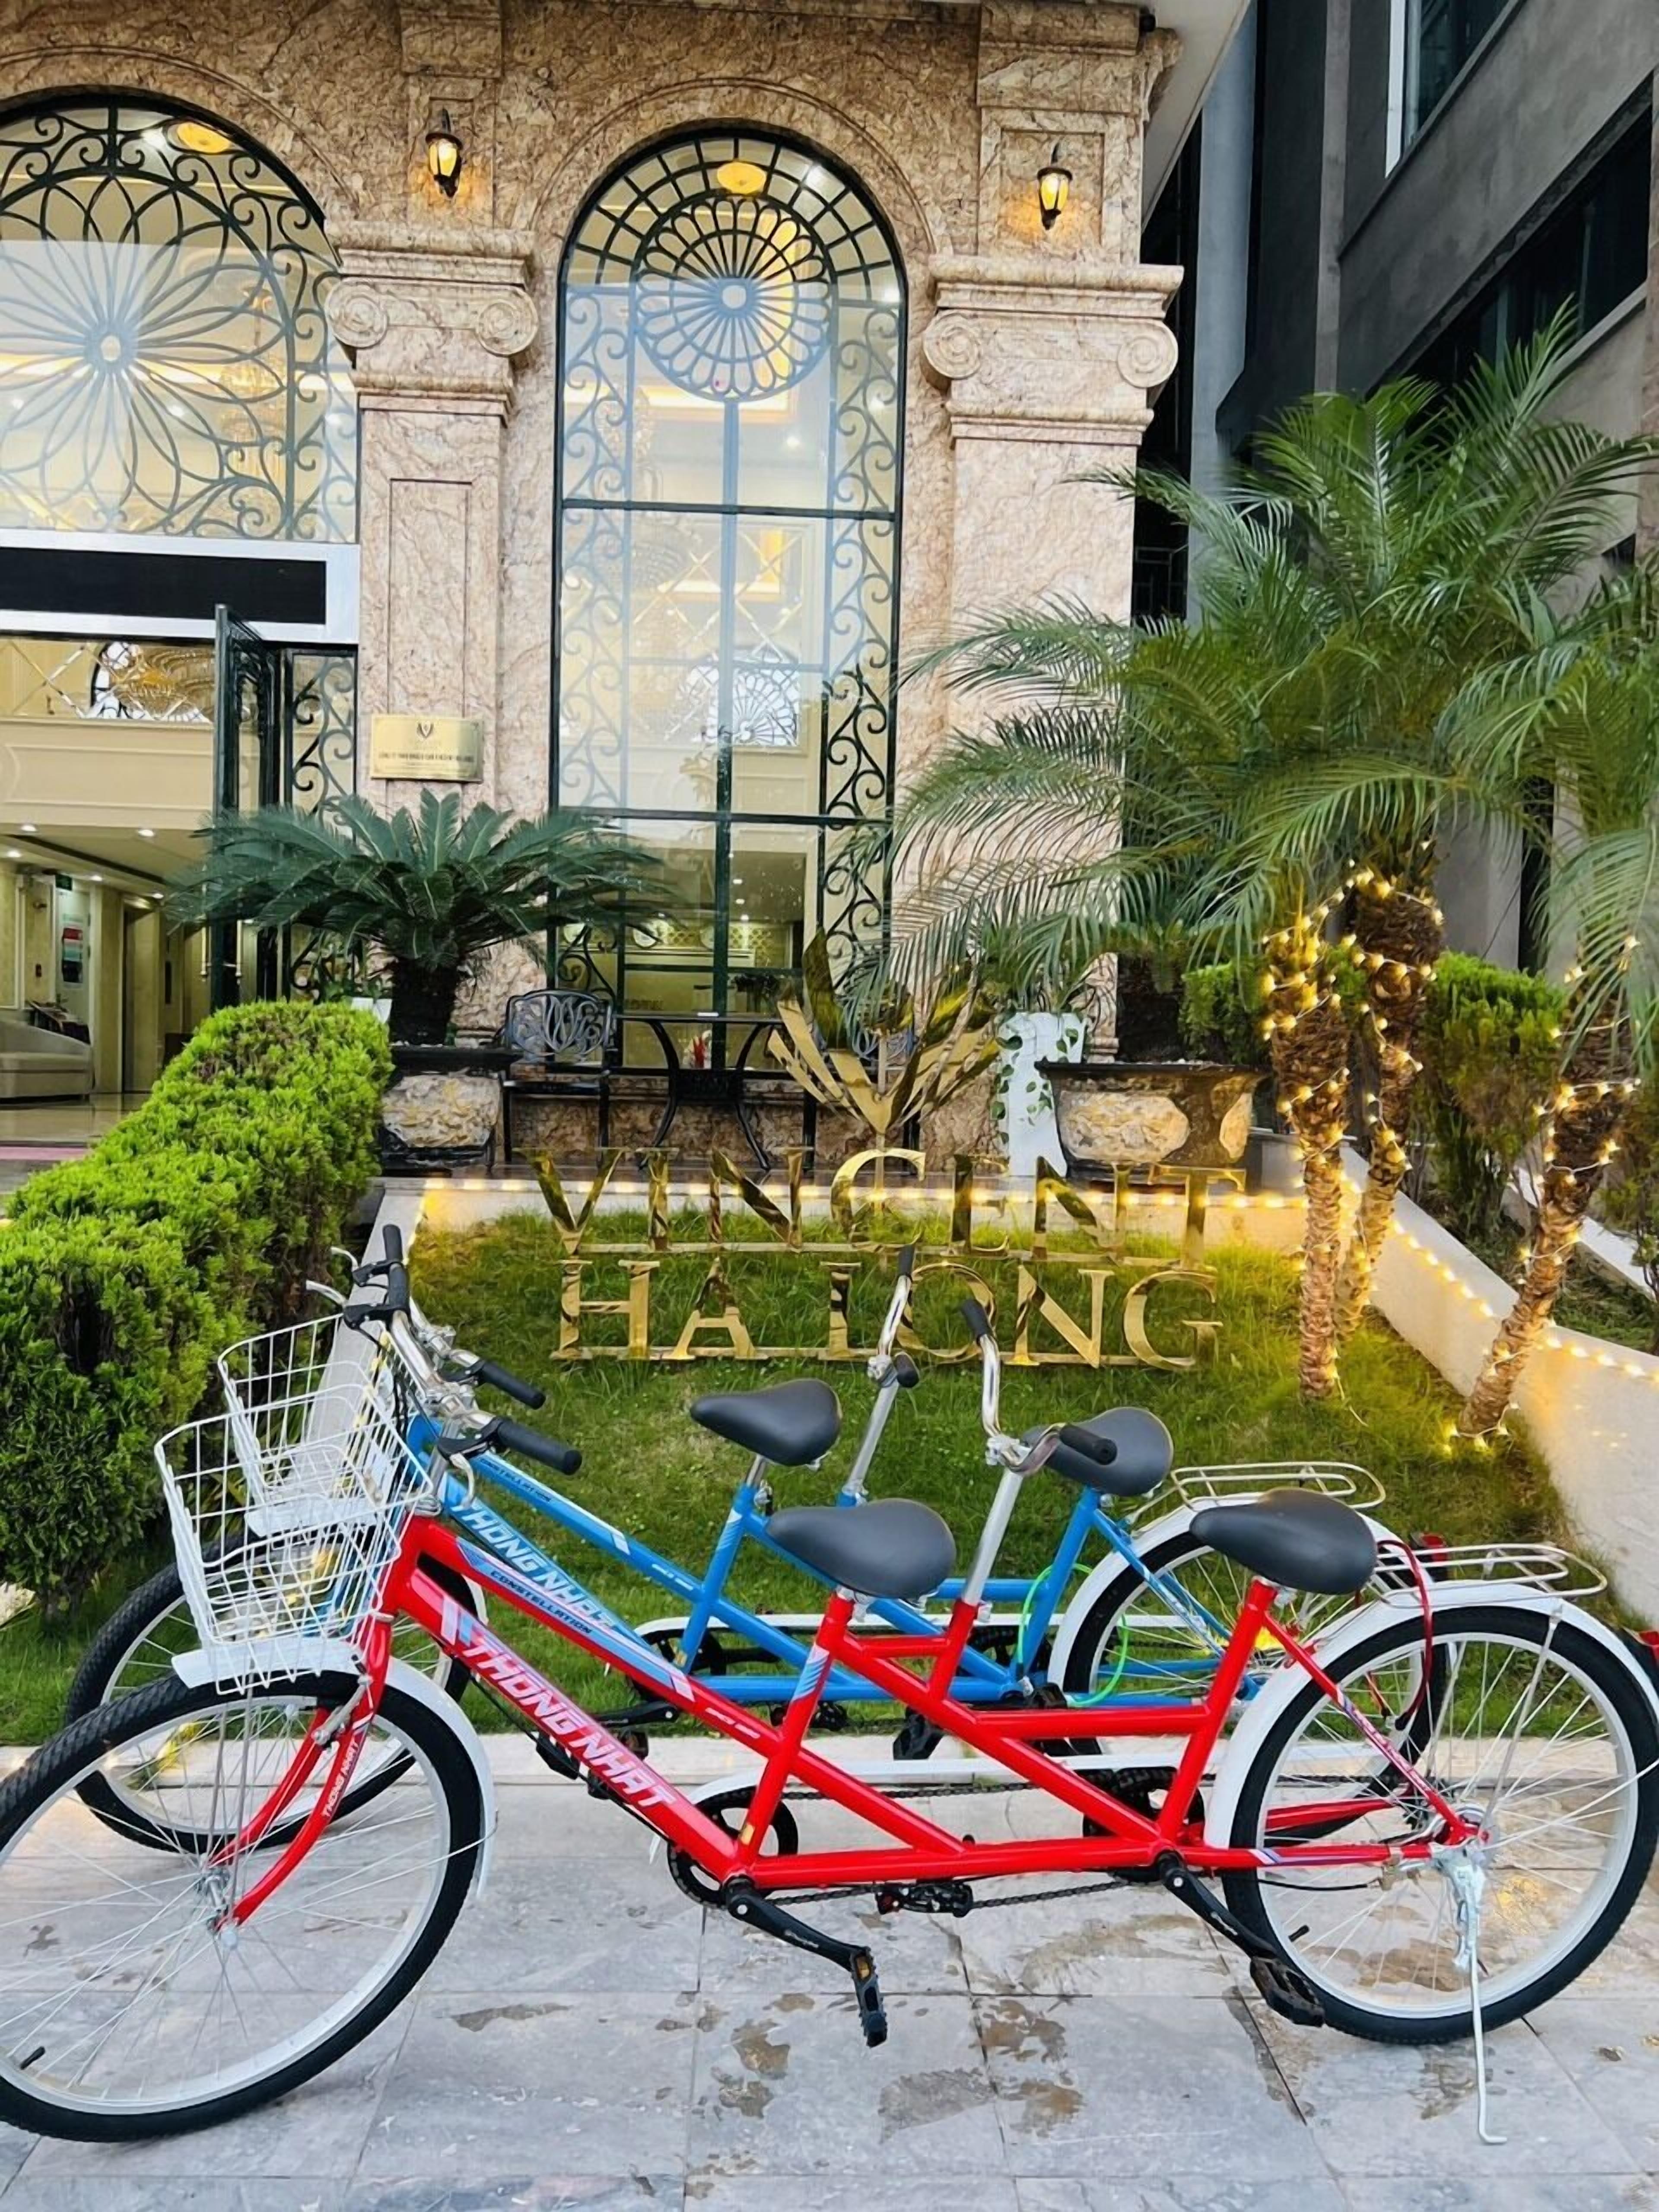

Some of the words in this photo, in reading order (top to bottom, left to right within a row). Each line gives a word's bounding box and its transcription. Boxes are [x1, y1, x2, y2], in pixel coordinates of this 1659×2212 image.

[513, 1146, 1246, 1271] VINCENT
[550, 1256, 769, 1360] HA
[490, 1569, 593, 1634] CONSTELLATION
[462, 1634, 585, 1735] THONG
[568, 1726, 677, 1807] NHAT
